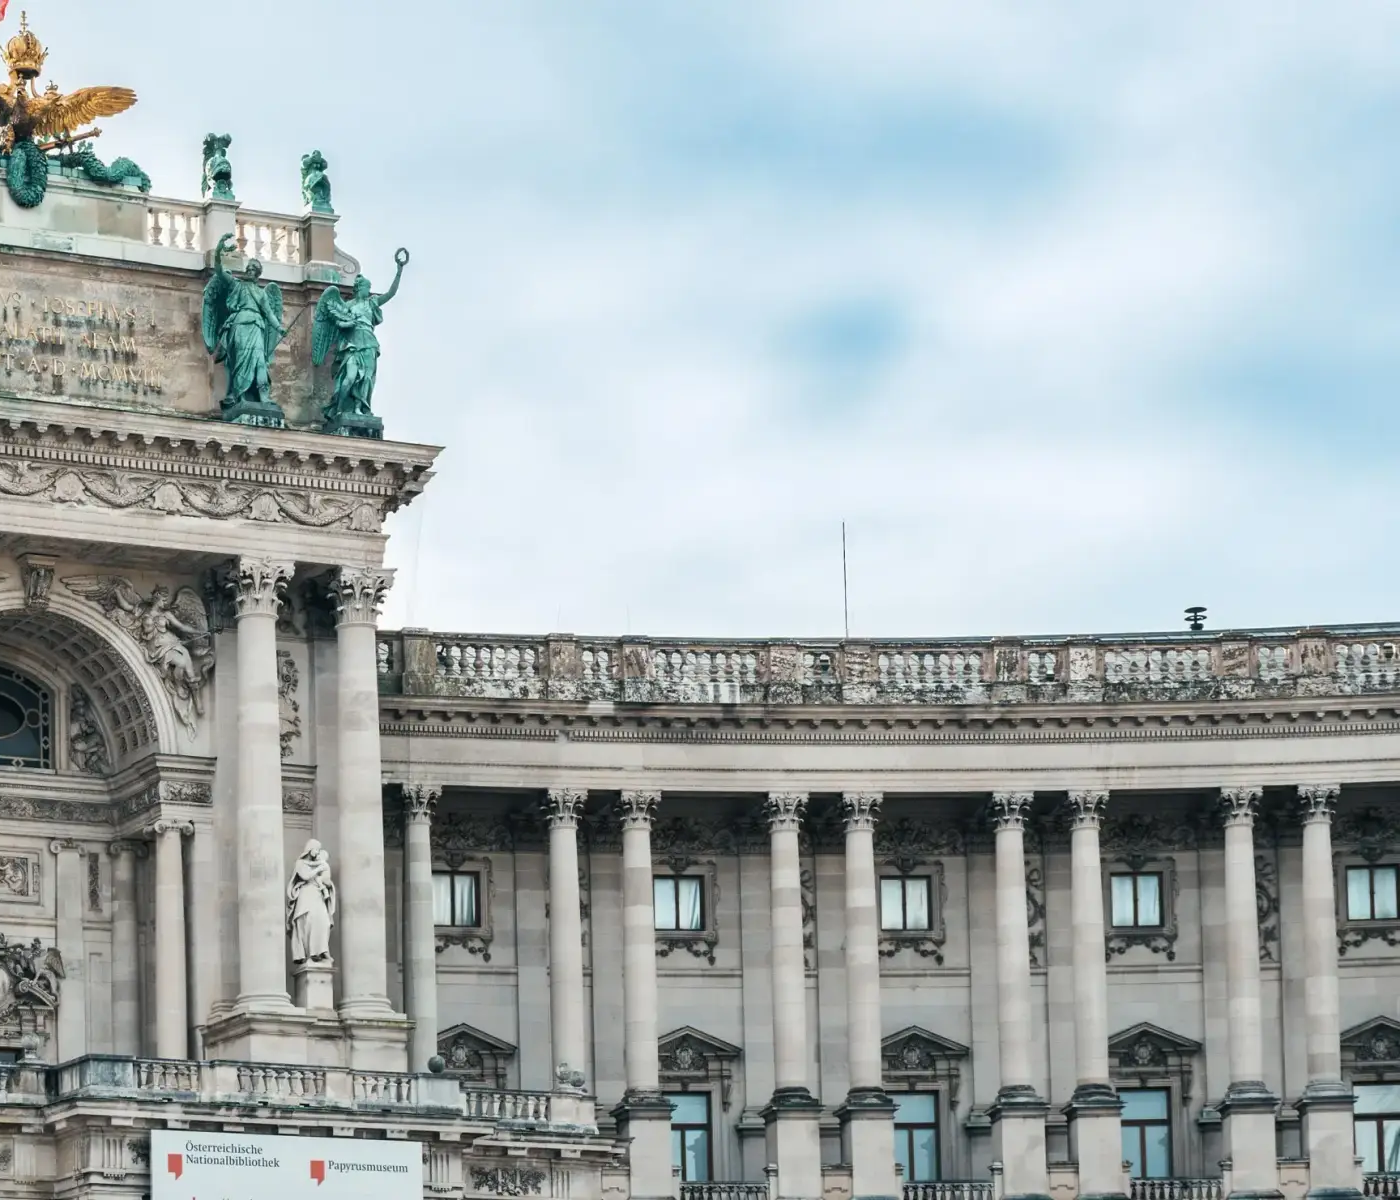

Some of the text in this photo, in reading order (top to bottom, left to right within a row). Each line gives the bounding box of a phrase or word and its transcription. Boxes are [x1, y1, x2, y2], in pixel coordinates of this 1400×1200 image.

[185, 1139, 263, 1155] Österreichische
[185, 1154, 280, 1168] Nationalbibliothek
[328, 1159, 408, 1174] Papyrusmuseum
